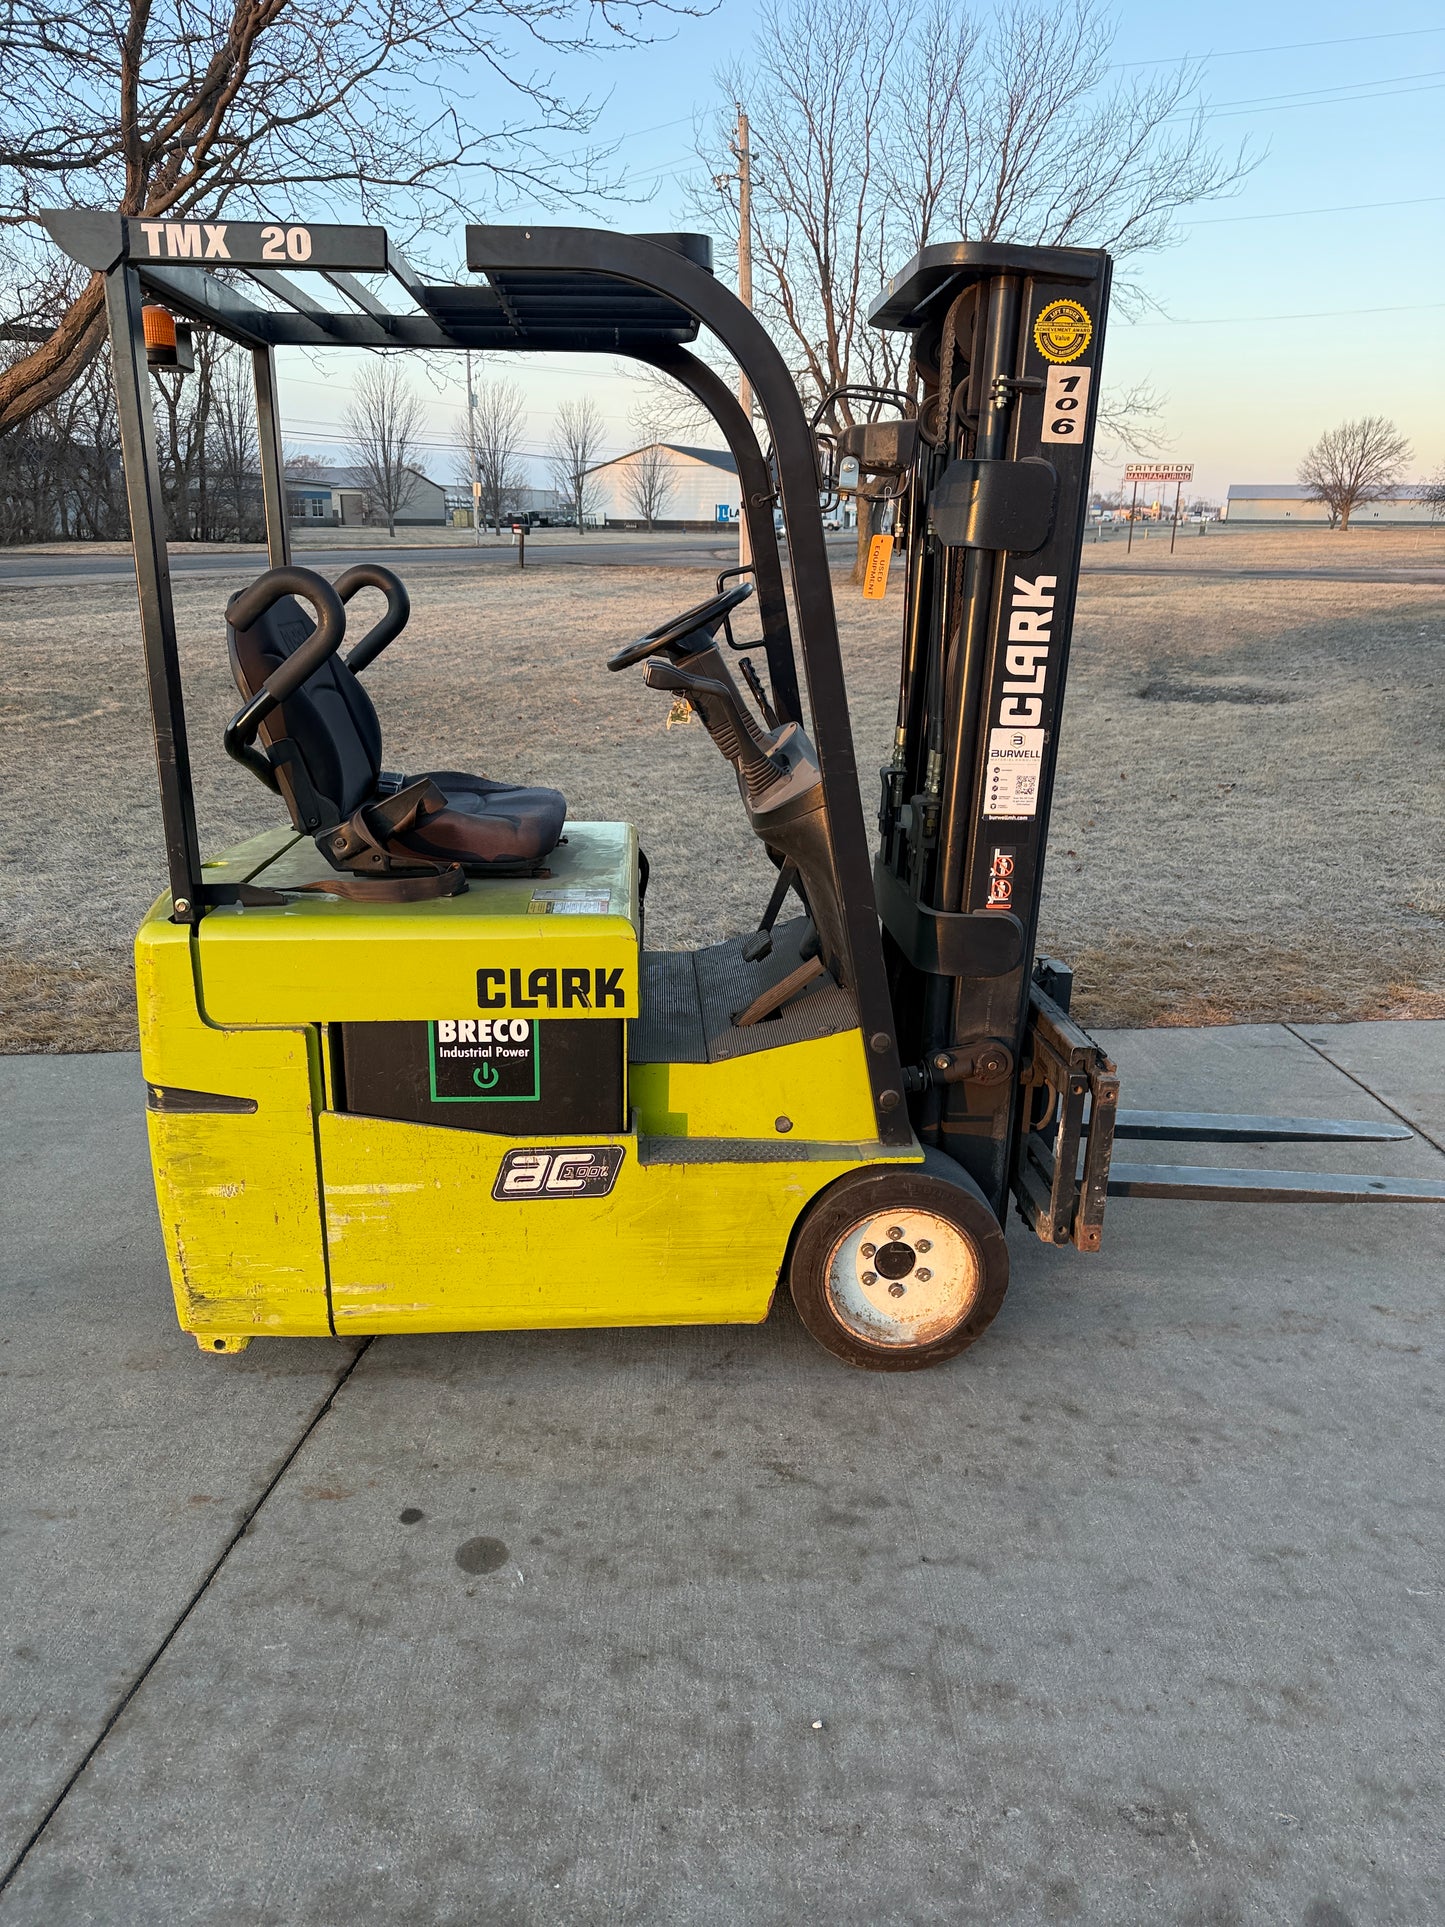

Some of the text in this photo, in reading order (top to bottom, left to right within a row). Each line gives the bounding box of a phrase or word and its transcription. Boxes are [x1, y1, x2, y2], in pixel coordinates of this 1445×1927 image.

[141, 223, 312, 262] TMX 20
[1050, 308, 1080, 320] LIFT TRUCK
[1051, 376, 1081, 434] 106
[868, 545, 880, 596] EQUIPMENT
[877, 560, 885, 582] USED
[999, 575, 1057, 726] CLARK
[991, 749, 1040, 758] BURWELL
[476, 968, 625, 1008] CLARK
[438, 1018, 529, 1043] BRECO
[440, 1045, 529, 1058] Industrial Power
